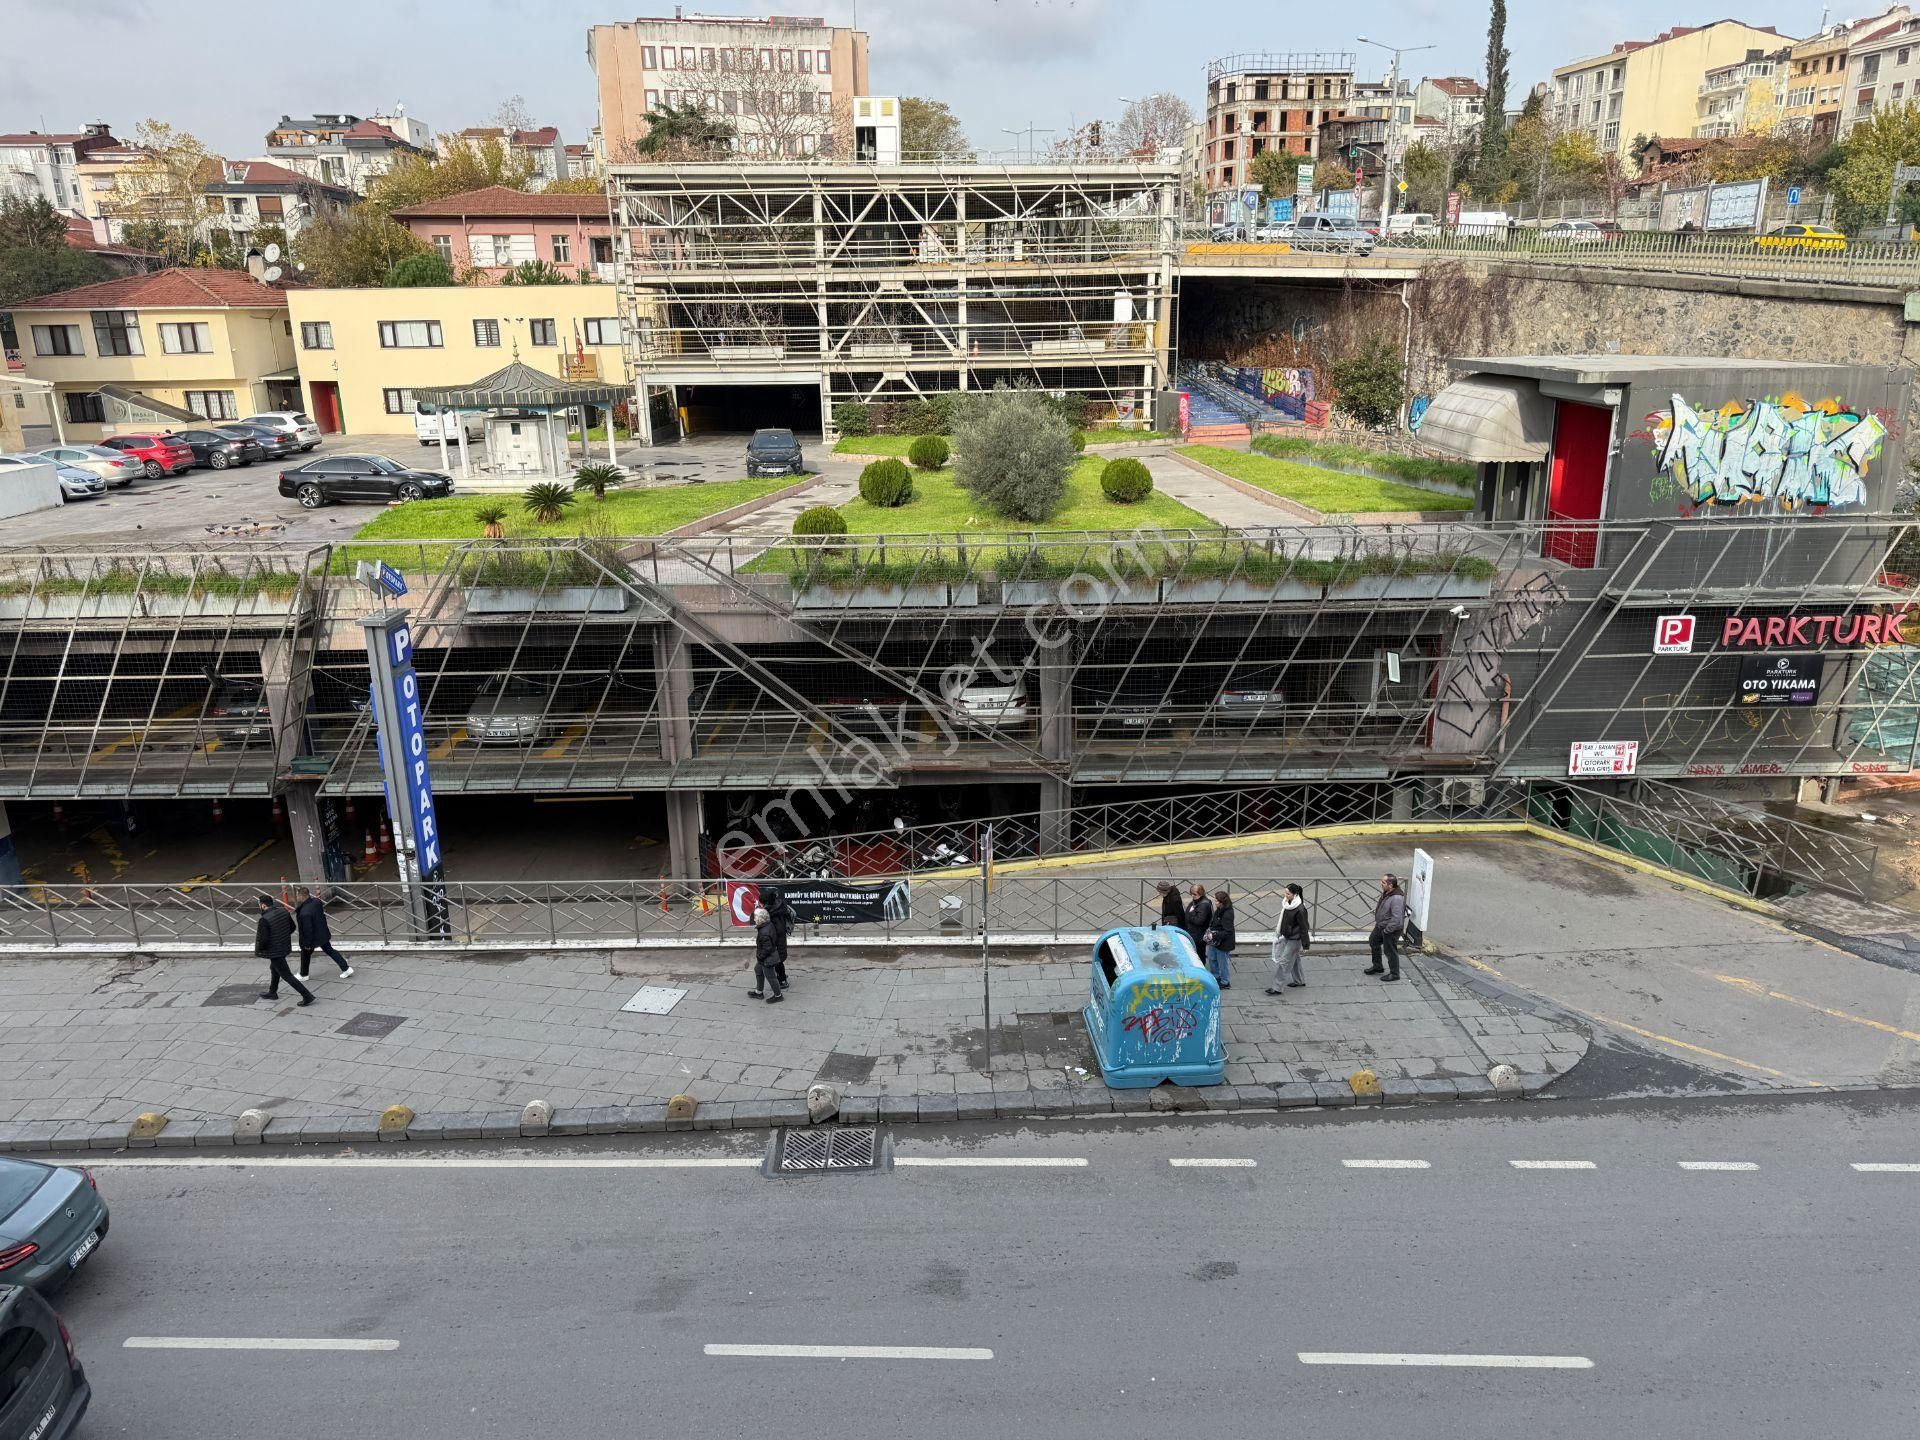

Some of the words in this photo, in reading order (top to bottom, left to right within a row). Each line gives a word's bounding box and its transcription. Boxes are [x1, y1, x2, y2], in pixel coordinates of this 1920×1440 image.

[394, 628, 409, 664] P
[1721, 614, 1908, 647] PARKTURK
[1743, 680, 1767, 689] OTO
[1771, 680, 1816, 689] YIKAMA
[403, 678, 438, 869] OTOPARK
